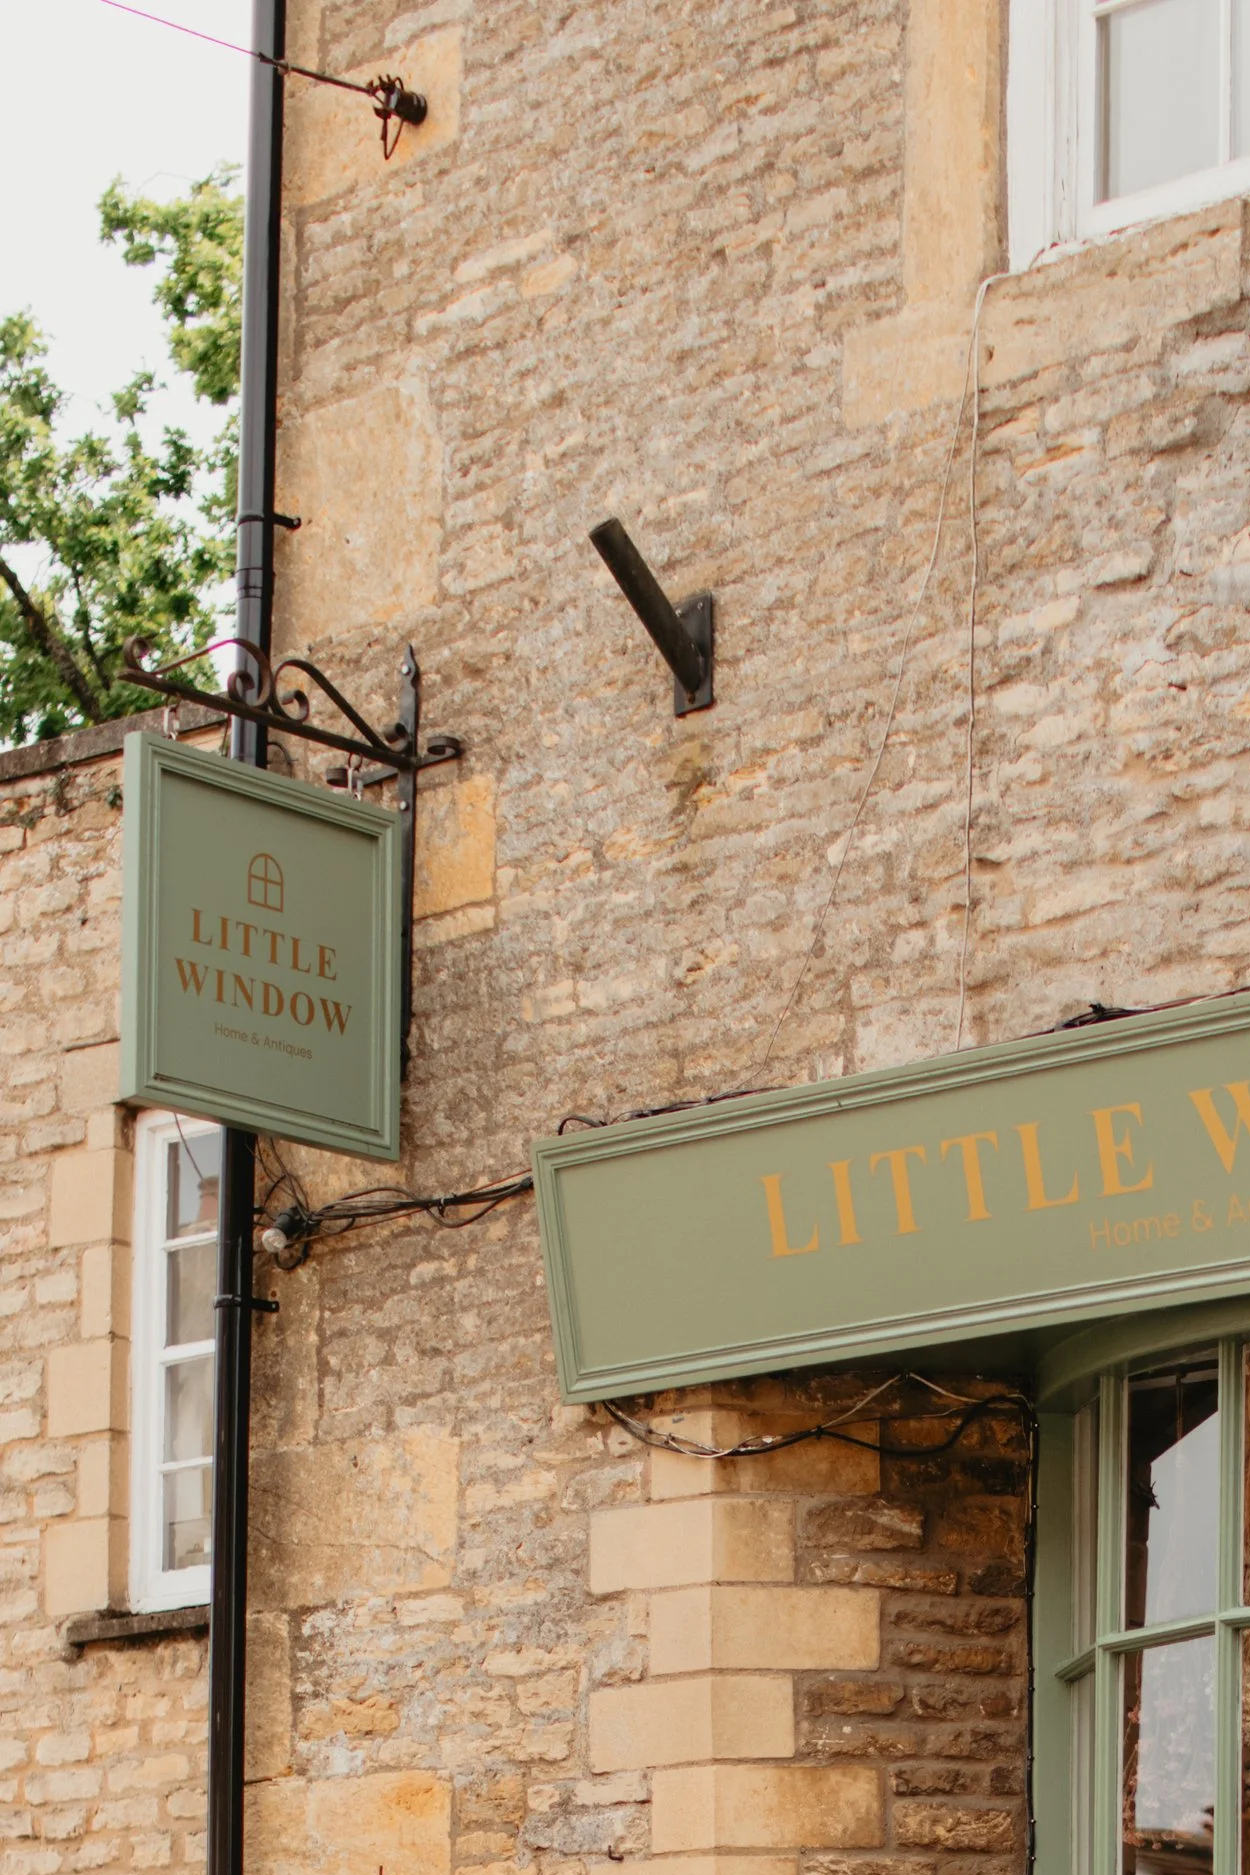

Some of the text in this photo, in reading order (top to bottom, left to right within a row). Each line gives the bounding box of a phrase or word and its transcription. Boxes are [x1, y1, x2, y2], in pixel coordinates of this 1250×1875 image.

[190, 907, 338, 981] LITTLE
[174, 957, 352, 1036] WINDOW
[214, 1022, 313, 1060] Home & Antiques
[759, 1102, 1155, 1259] LITTLE
[1088, 1209, 1181, 1251] Home
[1191, 1200, 1214, 1233] &
